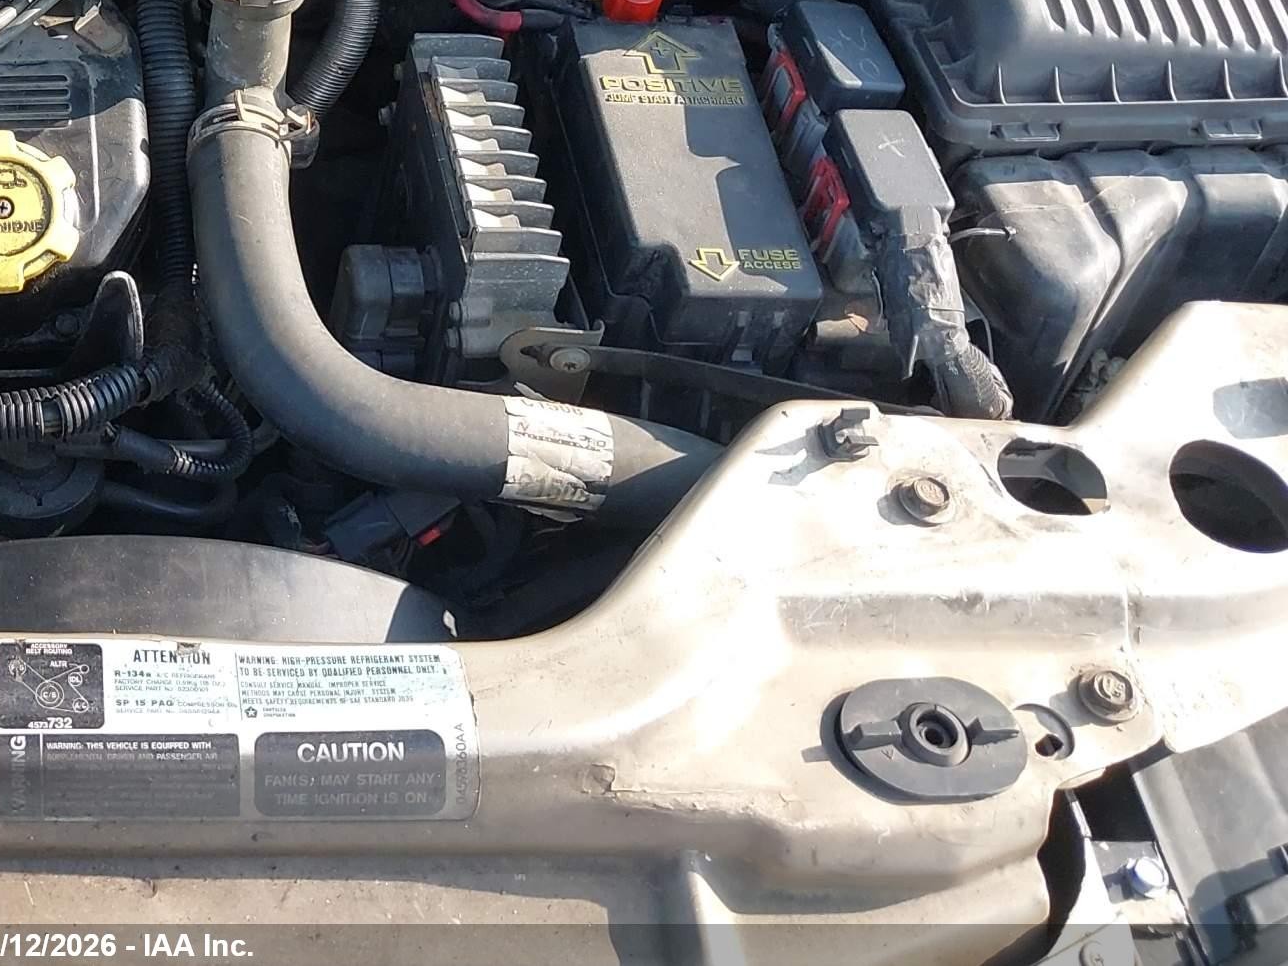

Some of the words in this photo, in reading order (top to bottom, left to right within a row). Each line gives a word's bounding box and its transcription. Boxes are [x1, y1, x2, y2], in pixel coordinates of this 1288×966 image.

[600, 76, 744, 93] POSITIVE
[738, 248, 800, 262] FUSE
[743, 260, 802, 270] ACCESS
[282, 655, 347, 665] HIGH-PRESSURE
[350, 654, 405, 665] REFRIGERANT
[408, 654, 441, 663] SYSTEM
[239, 666, 250, 676] TO
[253, 667, 263, 676] BE
[266, 667, 305, 677] SERVICED
[308, 667, 318, 677] BY
[321, 667, 363, 678] QUALIFIED
[365, 665, 413, 675] PERSONNEL
[151, 699, 174, 707] PAG
[151, 742, 190, 750] EQUIPPED
[297, 741, 405, 763] CAUTION
[156, 753, 203, 761] PASSENGER
[320, 774, 350, 786] MAY
[356, 773, 400, 786] START
[404, 773, 435, 785] ANY
[273, 793, 309, 806] TIME
[314, 793, 379, 806] IGNITION
[383, 792, 398, 805] IS
[404, 791, 428, 804] ON
